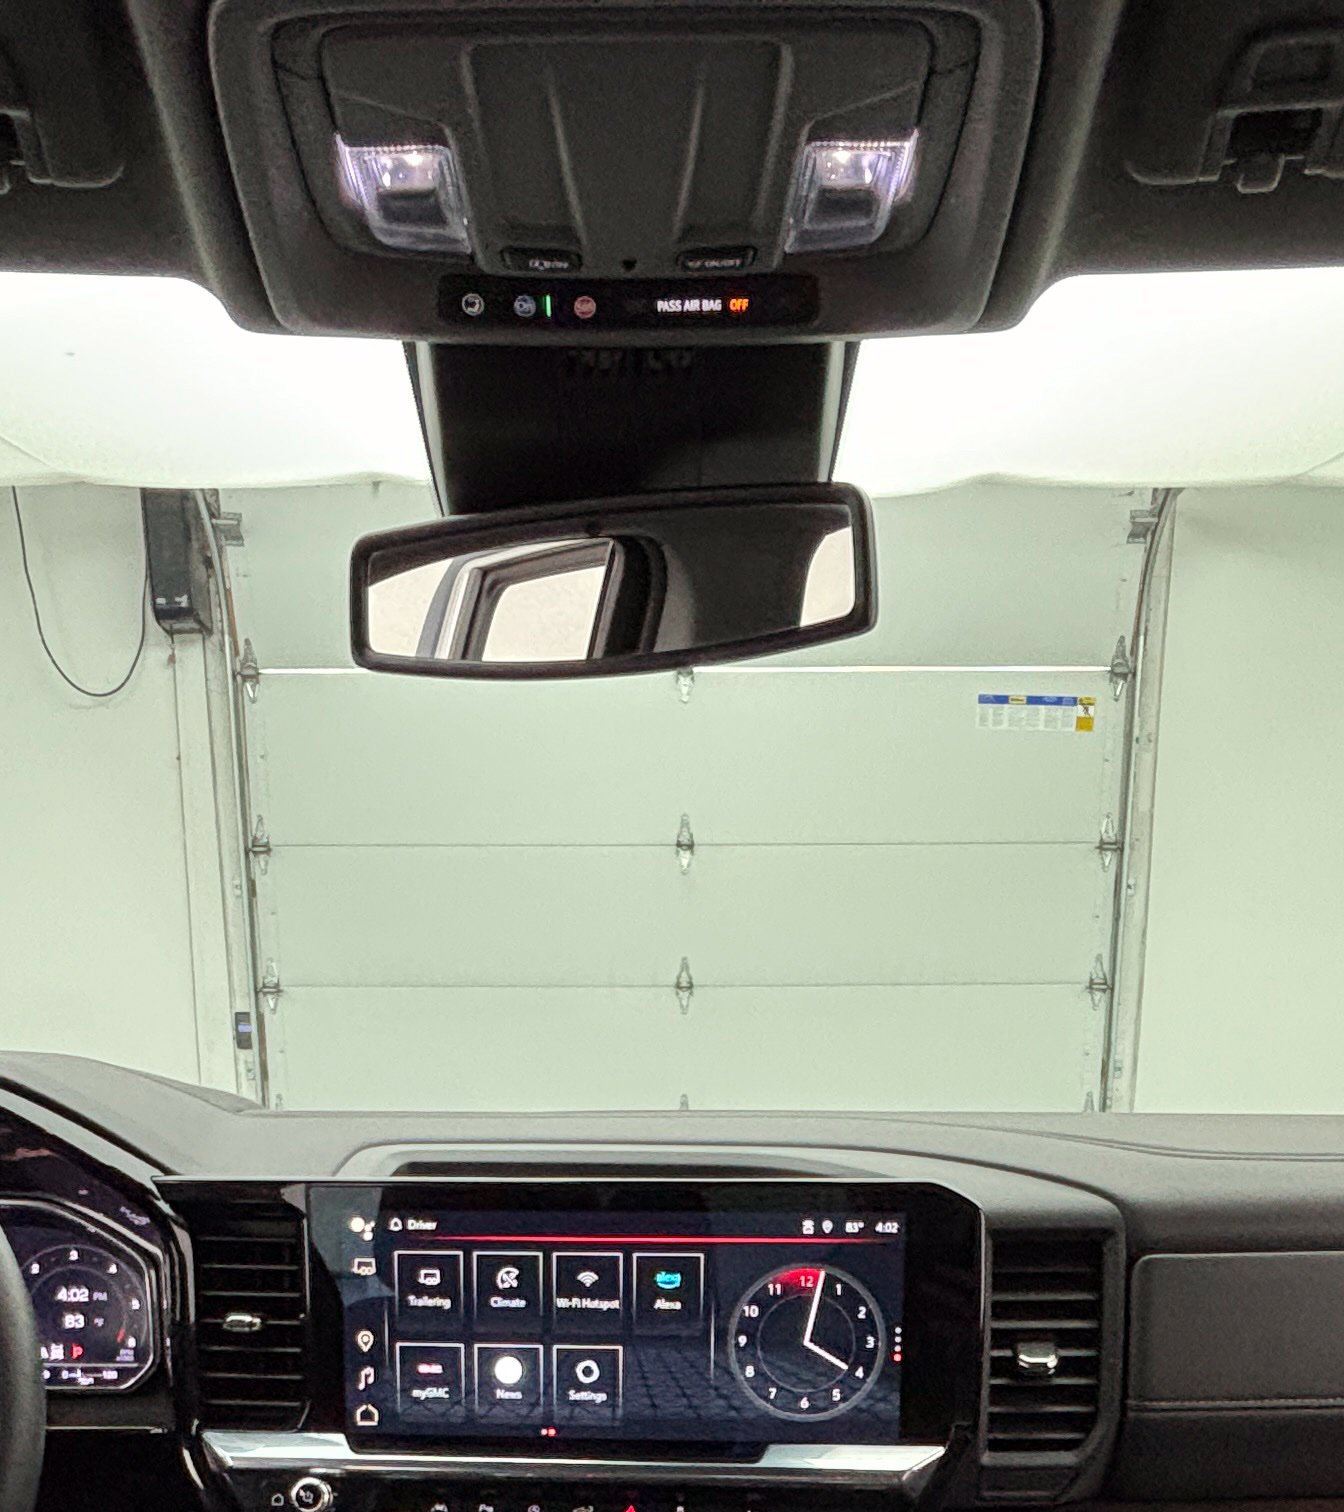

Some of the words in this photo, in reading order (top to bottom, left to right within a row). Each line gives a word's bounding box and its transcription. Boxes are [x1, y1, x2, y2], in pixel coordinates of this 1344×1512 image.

[657, 300, 682, 312] PASS
[683, 299, 701, 312] AIR
[701, 299, 722, 312] BAG
[729, 299, 749, 312] OFF
[407, 1219, 438, 1231] Driver
[875, 1222, 899, 1234] 4:02
[69, 1249, 79, 1261] 3
[799, 1274, 815, 1287] 12
[56, 1286, 89, 1302] 4:02
[768, 1283, 782, 1295] 11
[835, 1283, 843, 1295] 1
[408, 1295, 452, 1309] Trailering
[490, 1297, 527, 1308] Climate
[556, 1297, 584, 1308] Wi-Fi
[584, 1297, 621, 1310] Hotspot
[654, 1299, 682, 1310] Alexa
[744, 1305, 760, 1317] 10
[857, 1306, 867, 1319] 2
[64, 1313, 85, 1329] 83
[737, 1335, 747, 1347] 9
[865, 1336, 875, 1348] 3
[71, 1344, 84, 1360] P
[745, 1365, 755, 1378] 8
[854, 1366, 865, 1379] 4
[411, 1388, 450, 1400] myGMC
[495, 1388, 523, 1400] News
[568, 1390, 607, 1403] Settings
[768, 1387, 778, 1399] 7
[831, 1388, 842, 1400] 5
[800, 1397, 810, 1409] 6
